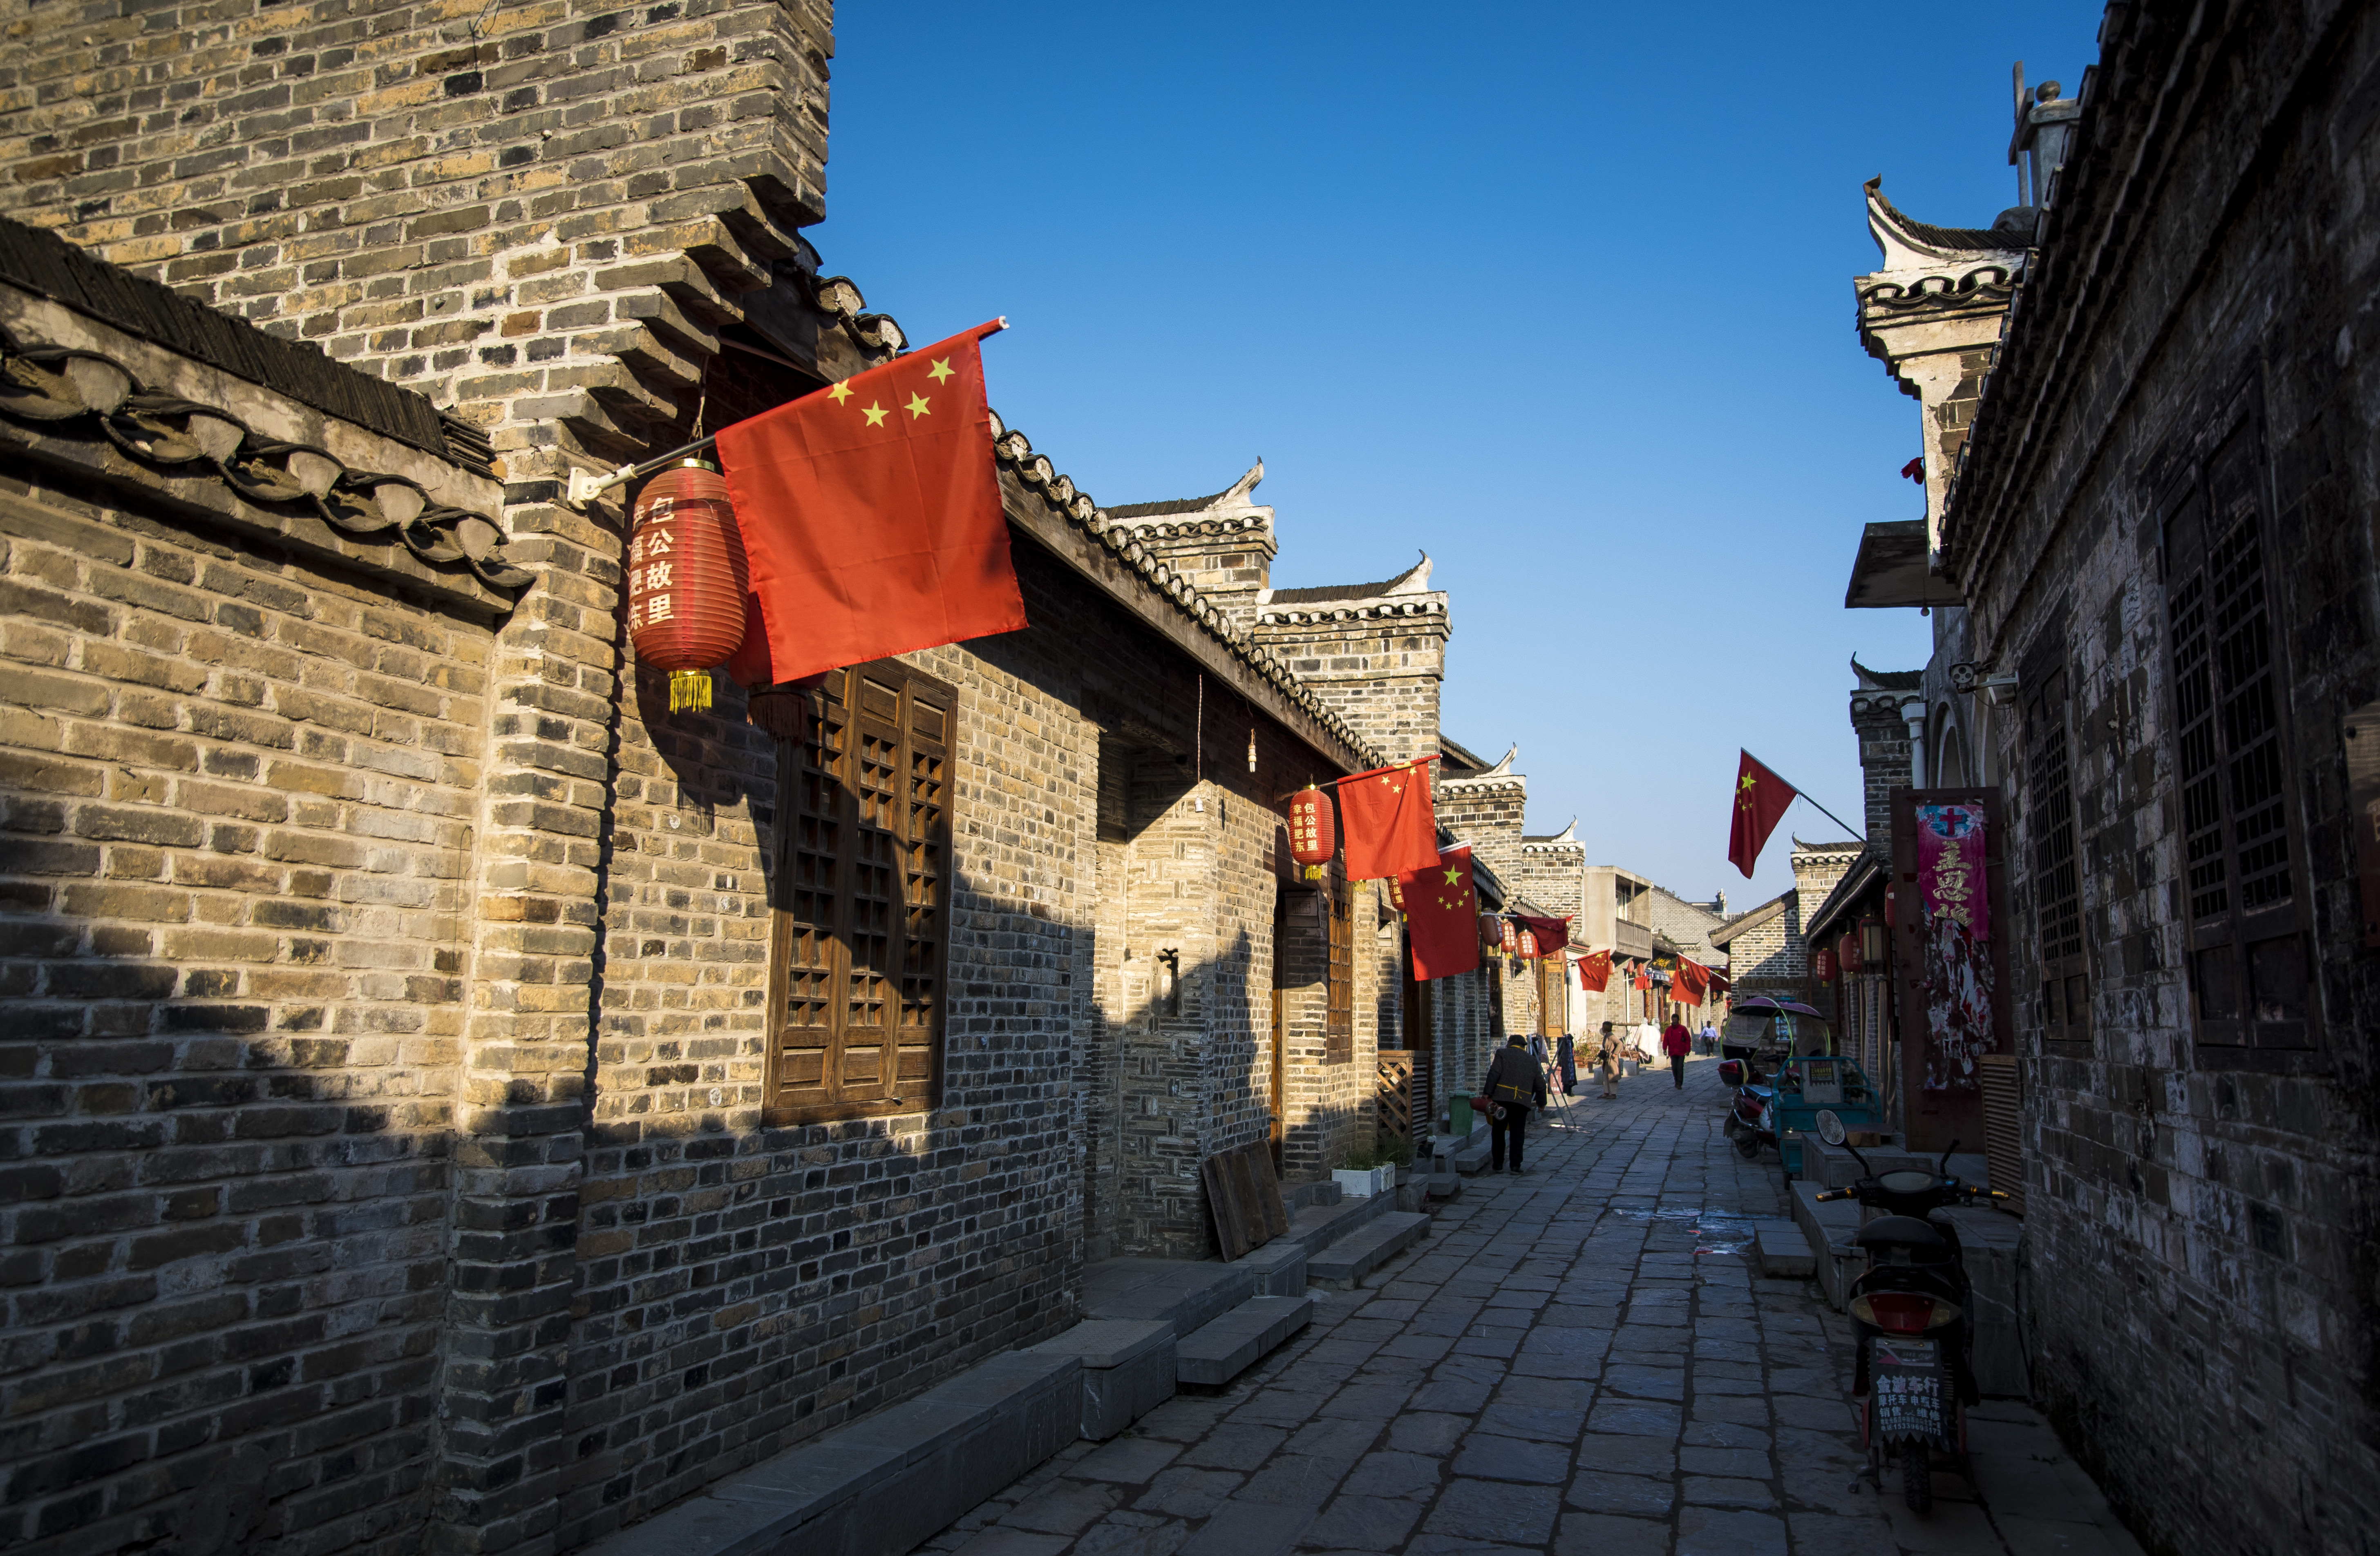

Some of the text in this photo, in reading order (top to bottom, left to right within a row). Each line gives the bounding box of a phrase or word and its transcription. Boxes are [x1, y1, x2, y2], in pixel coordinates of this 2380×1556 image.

[647, 497, 675, 625] 包公故里
[1293, 804, 1305, 852] 幸福肥东
[1304, 803, 1318, 851] 包公故里
[1391, 874, 1404, 903] 公故里
[1878, 1394, 1941, 1410] 摩托车 电瓶车
[1880, 1406, 1941, 1421] 销售 维修
